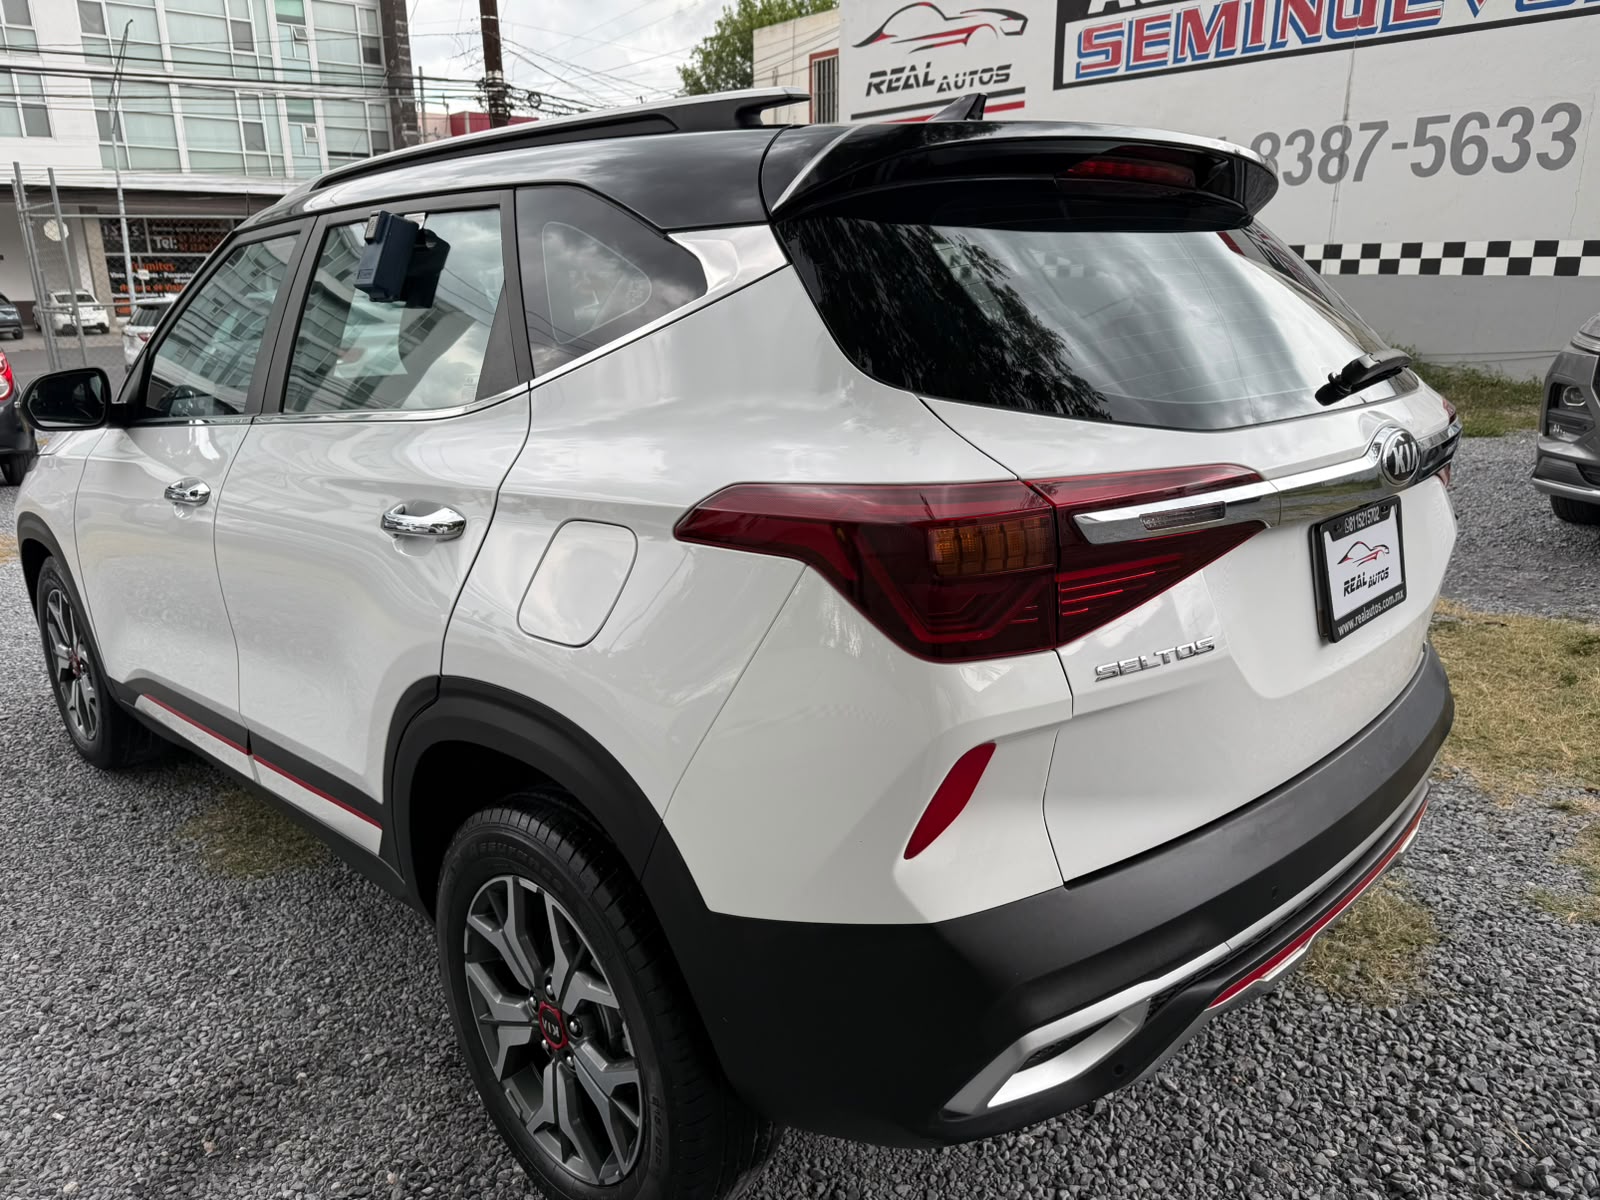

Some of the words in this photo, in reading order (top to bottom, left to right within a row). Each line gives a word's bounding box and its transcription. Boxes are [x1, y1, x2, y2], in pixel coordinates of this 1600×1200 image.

[866, 62, 935, 97] REAL
[936, 63, 1012, 93] AUTOS
[1392, 441, 1419, 475] KIA
[1344, 572, 1367, 597] REAL
[1368, 567, 1389, 588] AUTOS
[1338, 590, 1404, 636] www.realautos.com.mx
[1095, 636, 1215, 682] SELTOS
